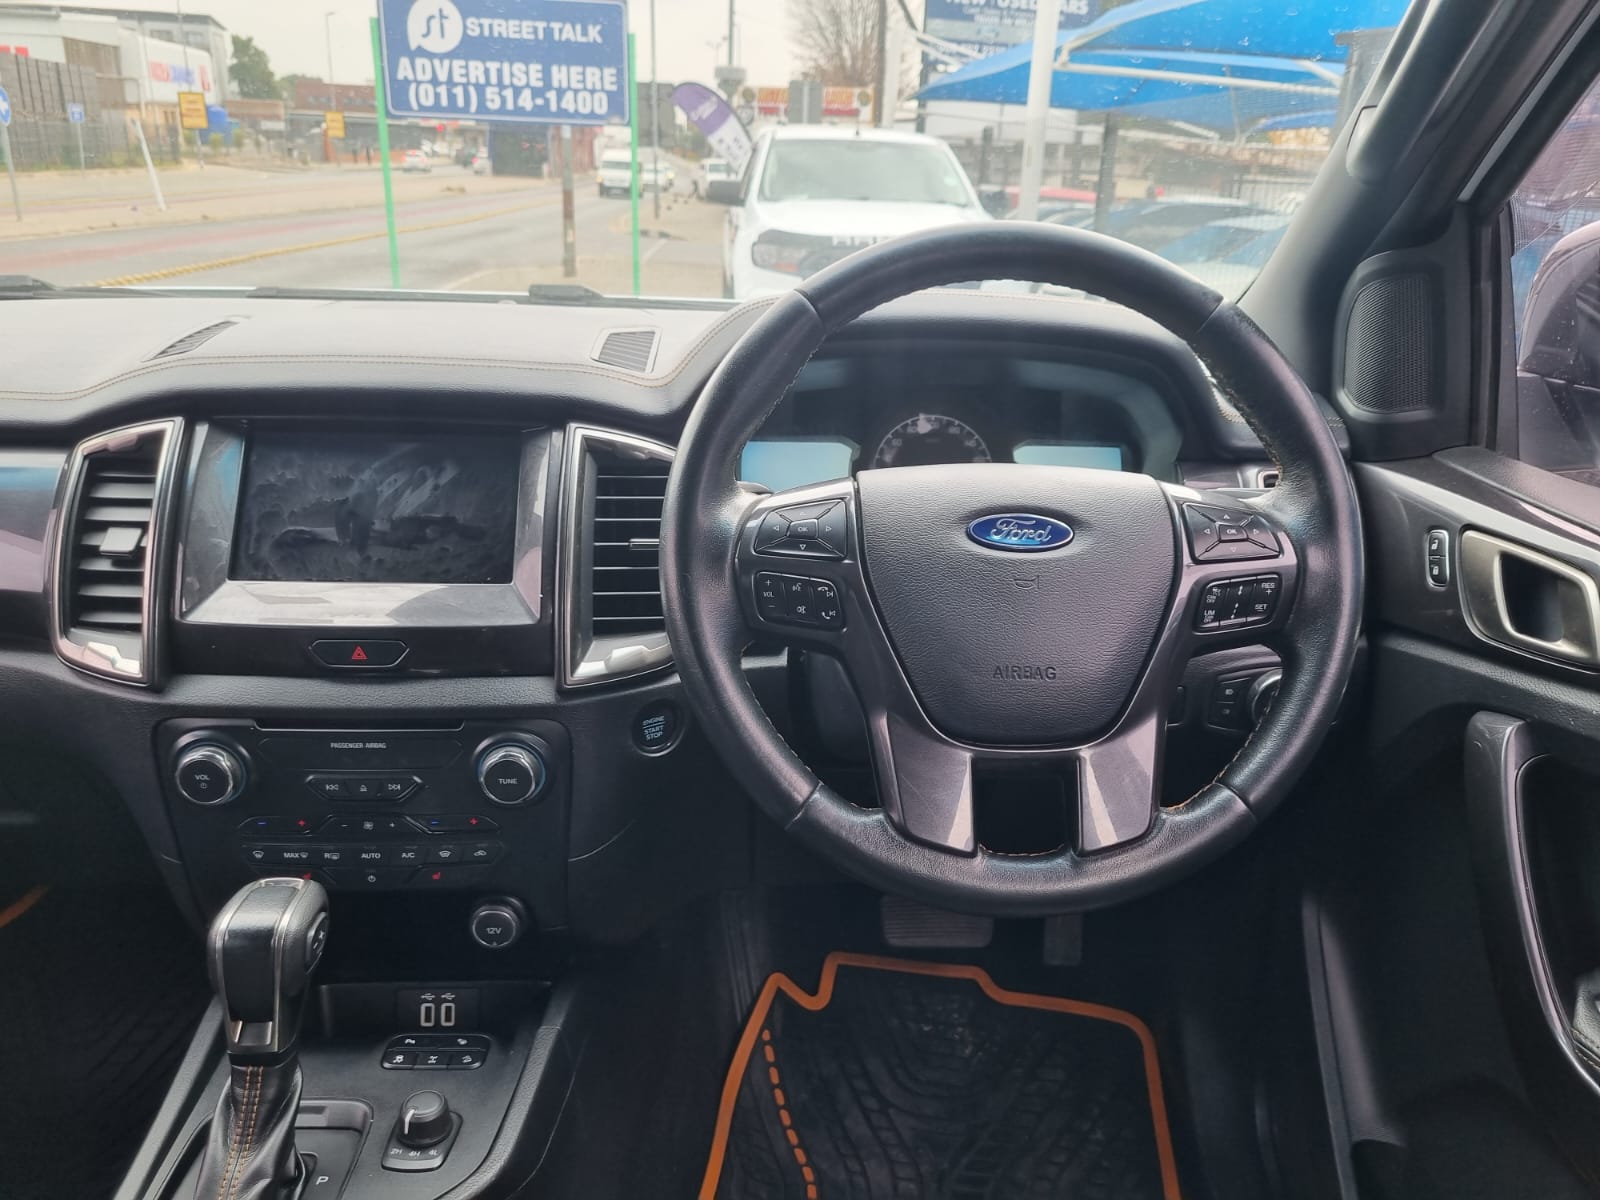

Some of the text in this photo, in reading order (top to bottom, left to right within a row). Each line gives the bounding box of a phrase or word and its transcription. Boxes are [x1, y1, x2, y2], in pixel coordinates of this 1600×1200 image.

[466, 17, 603, 43] STREET TALK
[397, 56, 618, 92] ADVERTISE HERE
[408, 82, 609, 116] (011) 514-1400
[990, 518, 1052, 541] Ford
[992, 665, 1057, 681] AIRBAG
[486, 927, 502, 935] 12V
[315, 1176, 329, 1185] P
